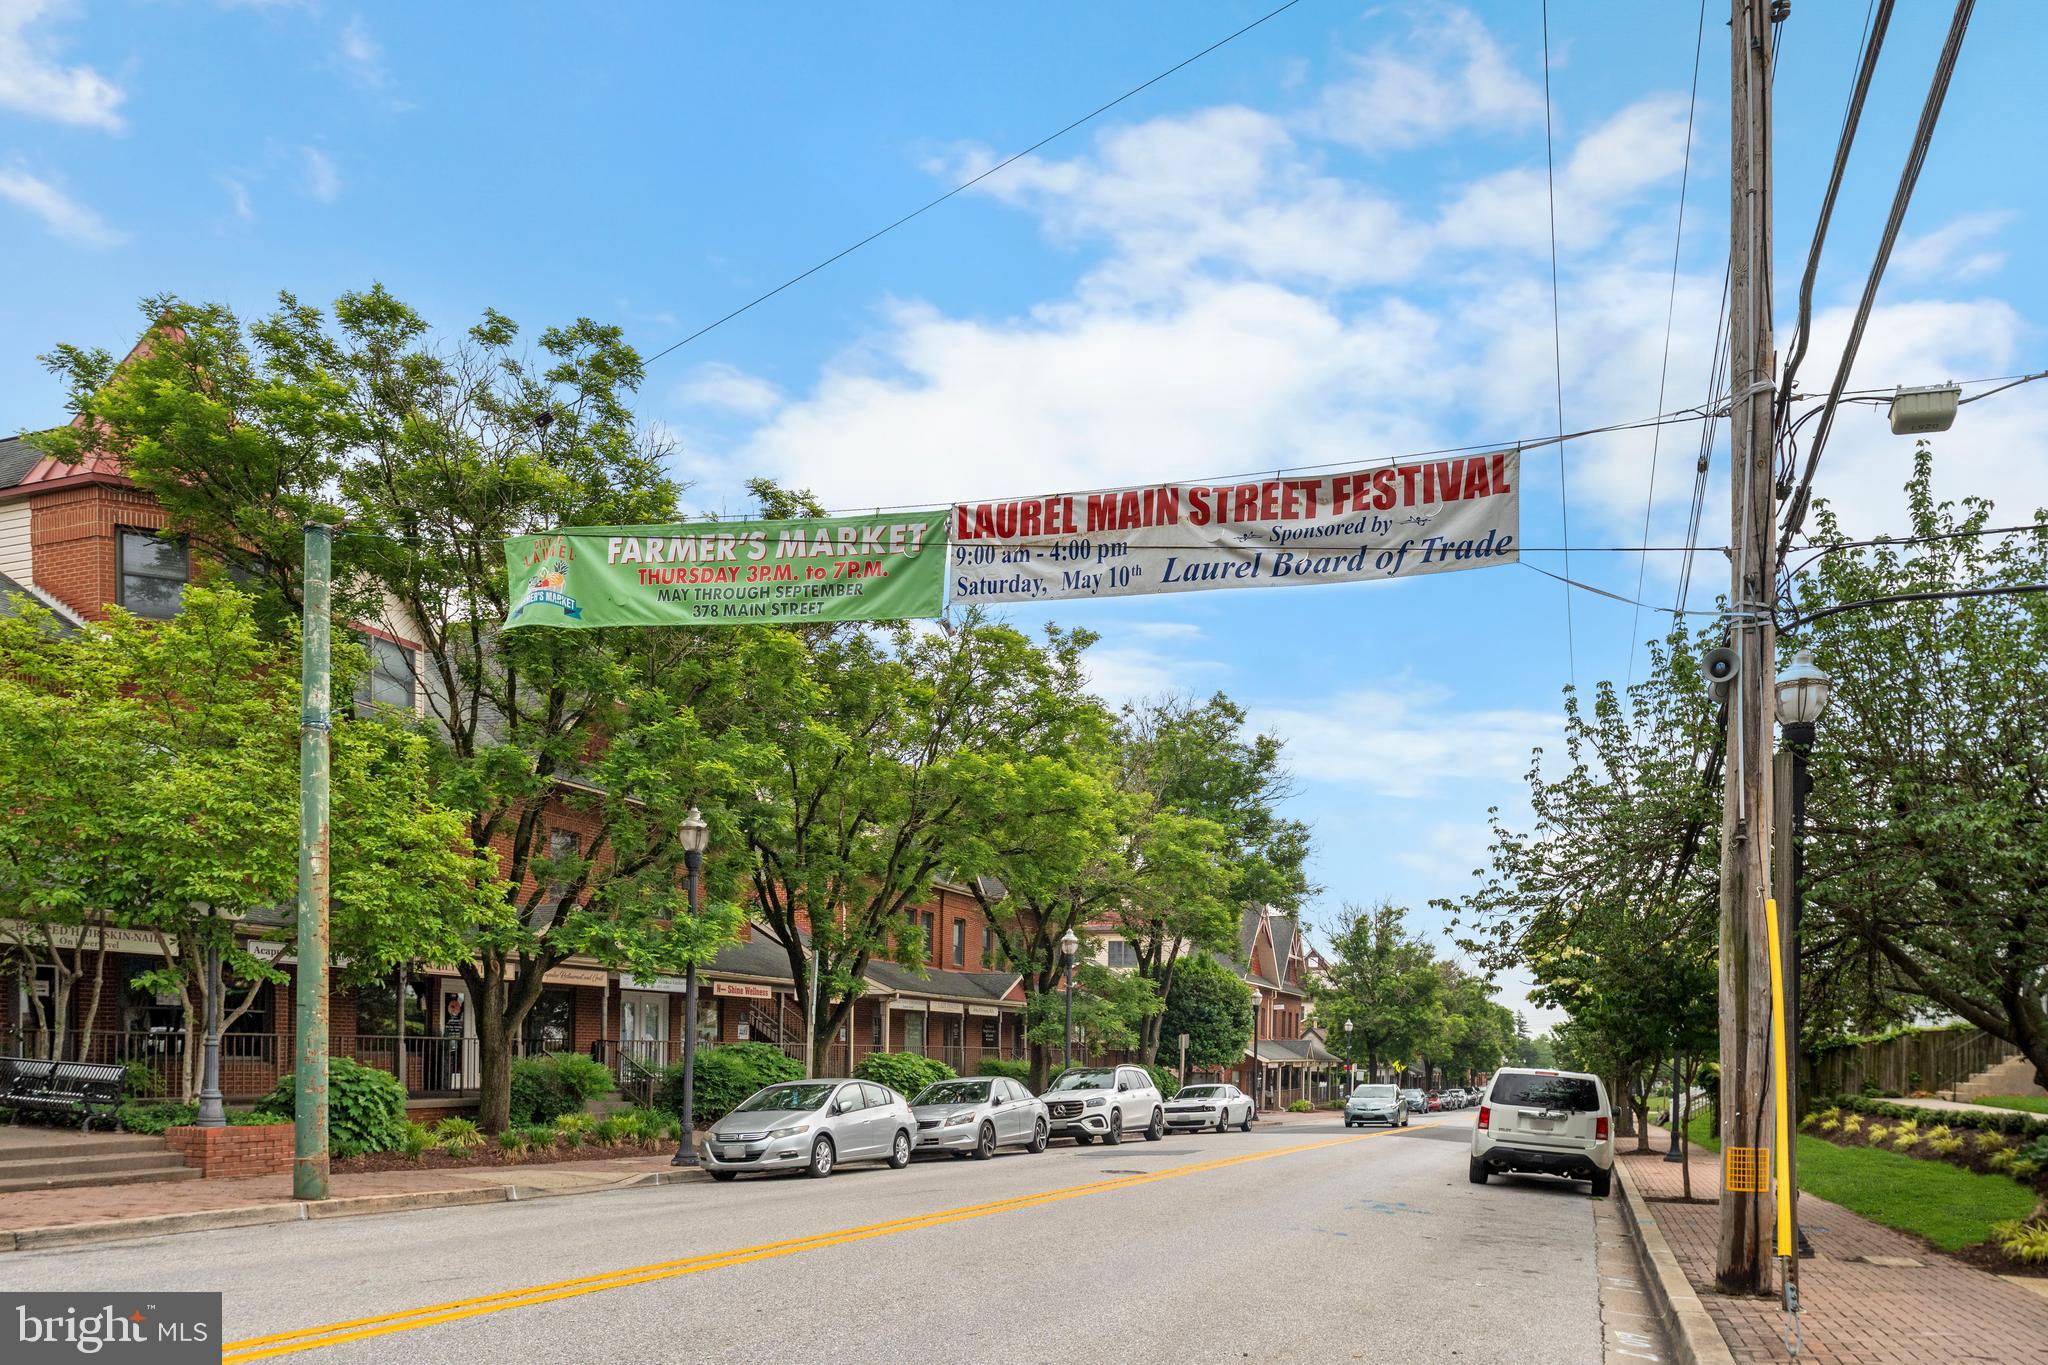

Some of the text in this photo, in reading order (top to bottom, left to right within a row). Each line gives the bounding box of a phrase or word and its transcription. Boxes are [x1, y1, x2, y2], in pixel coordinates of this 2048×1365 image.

[958, 454, 1510, 540] LAUREL MAIN STREET FESTIVAL
[608, 523, 928, 564] FARMER'S MARKET
[1269, 516, 1393, 545] Sponsored by
[956, 545, 996, 567] 9:00
[1001, 547, 1030, 563] am
[1050, 539, 1090, 561] 4:00
[1097, 540, 1127, 564] pm
[1161, 529, 1512, 583] Laurel Board of Trade
[638, 560, 889, 585] THURSDAY 3P.M. to 7P.M.
[957, 565, 1142, 597] Saturday, May 10th
[546, 591, 576, 610] MARKET
[657, 583, 865, 602] MAY THROUGH SEPTEMBER
[692, 601, 825, 618] 378 MAIN STREET
[59, 937, 73, 945] On
[727, 984, 744, 995] Shine
[745, 986, 769, 997] Wellness
